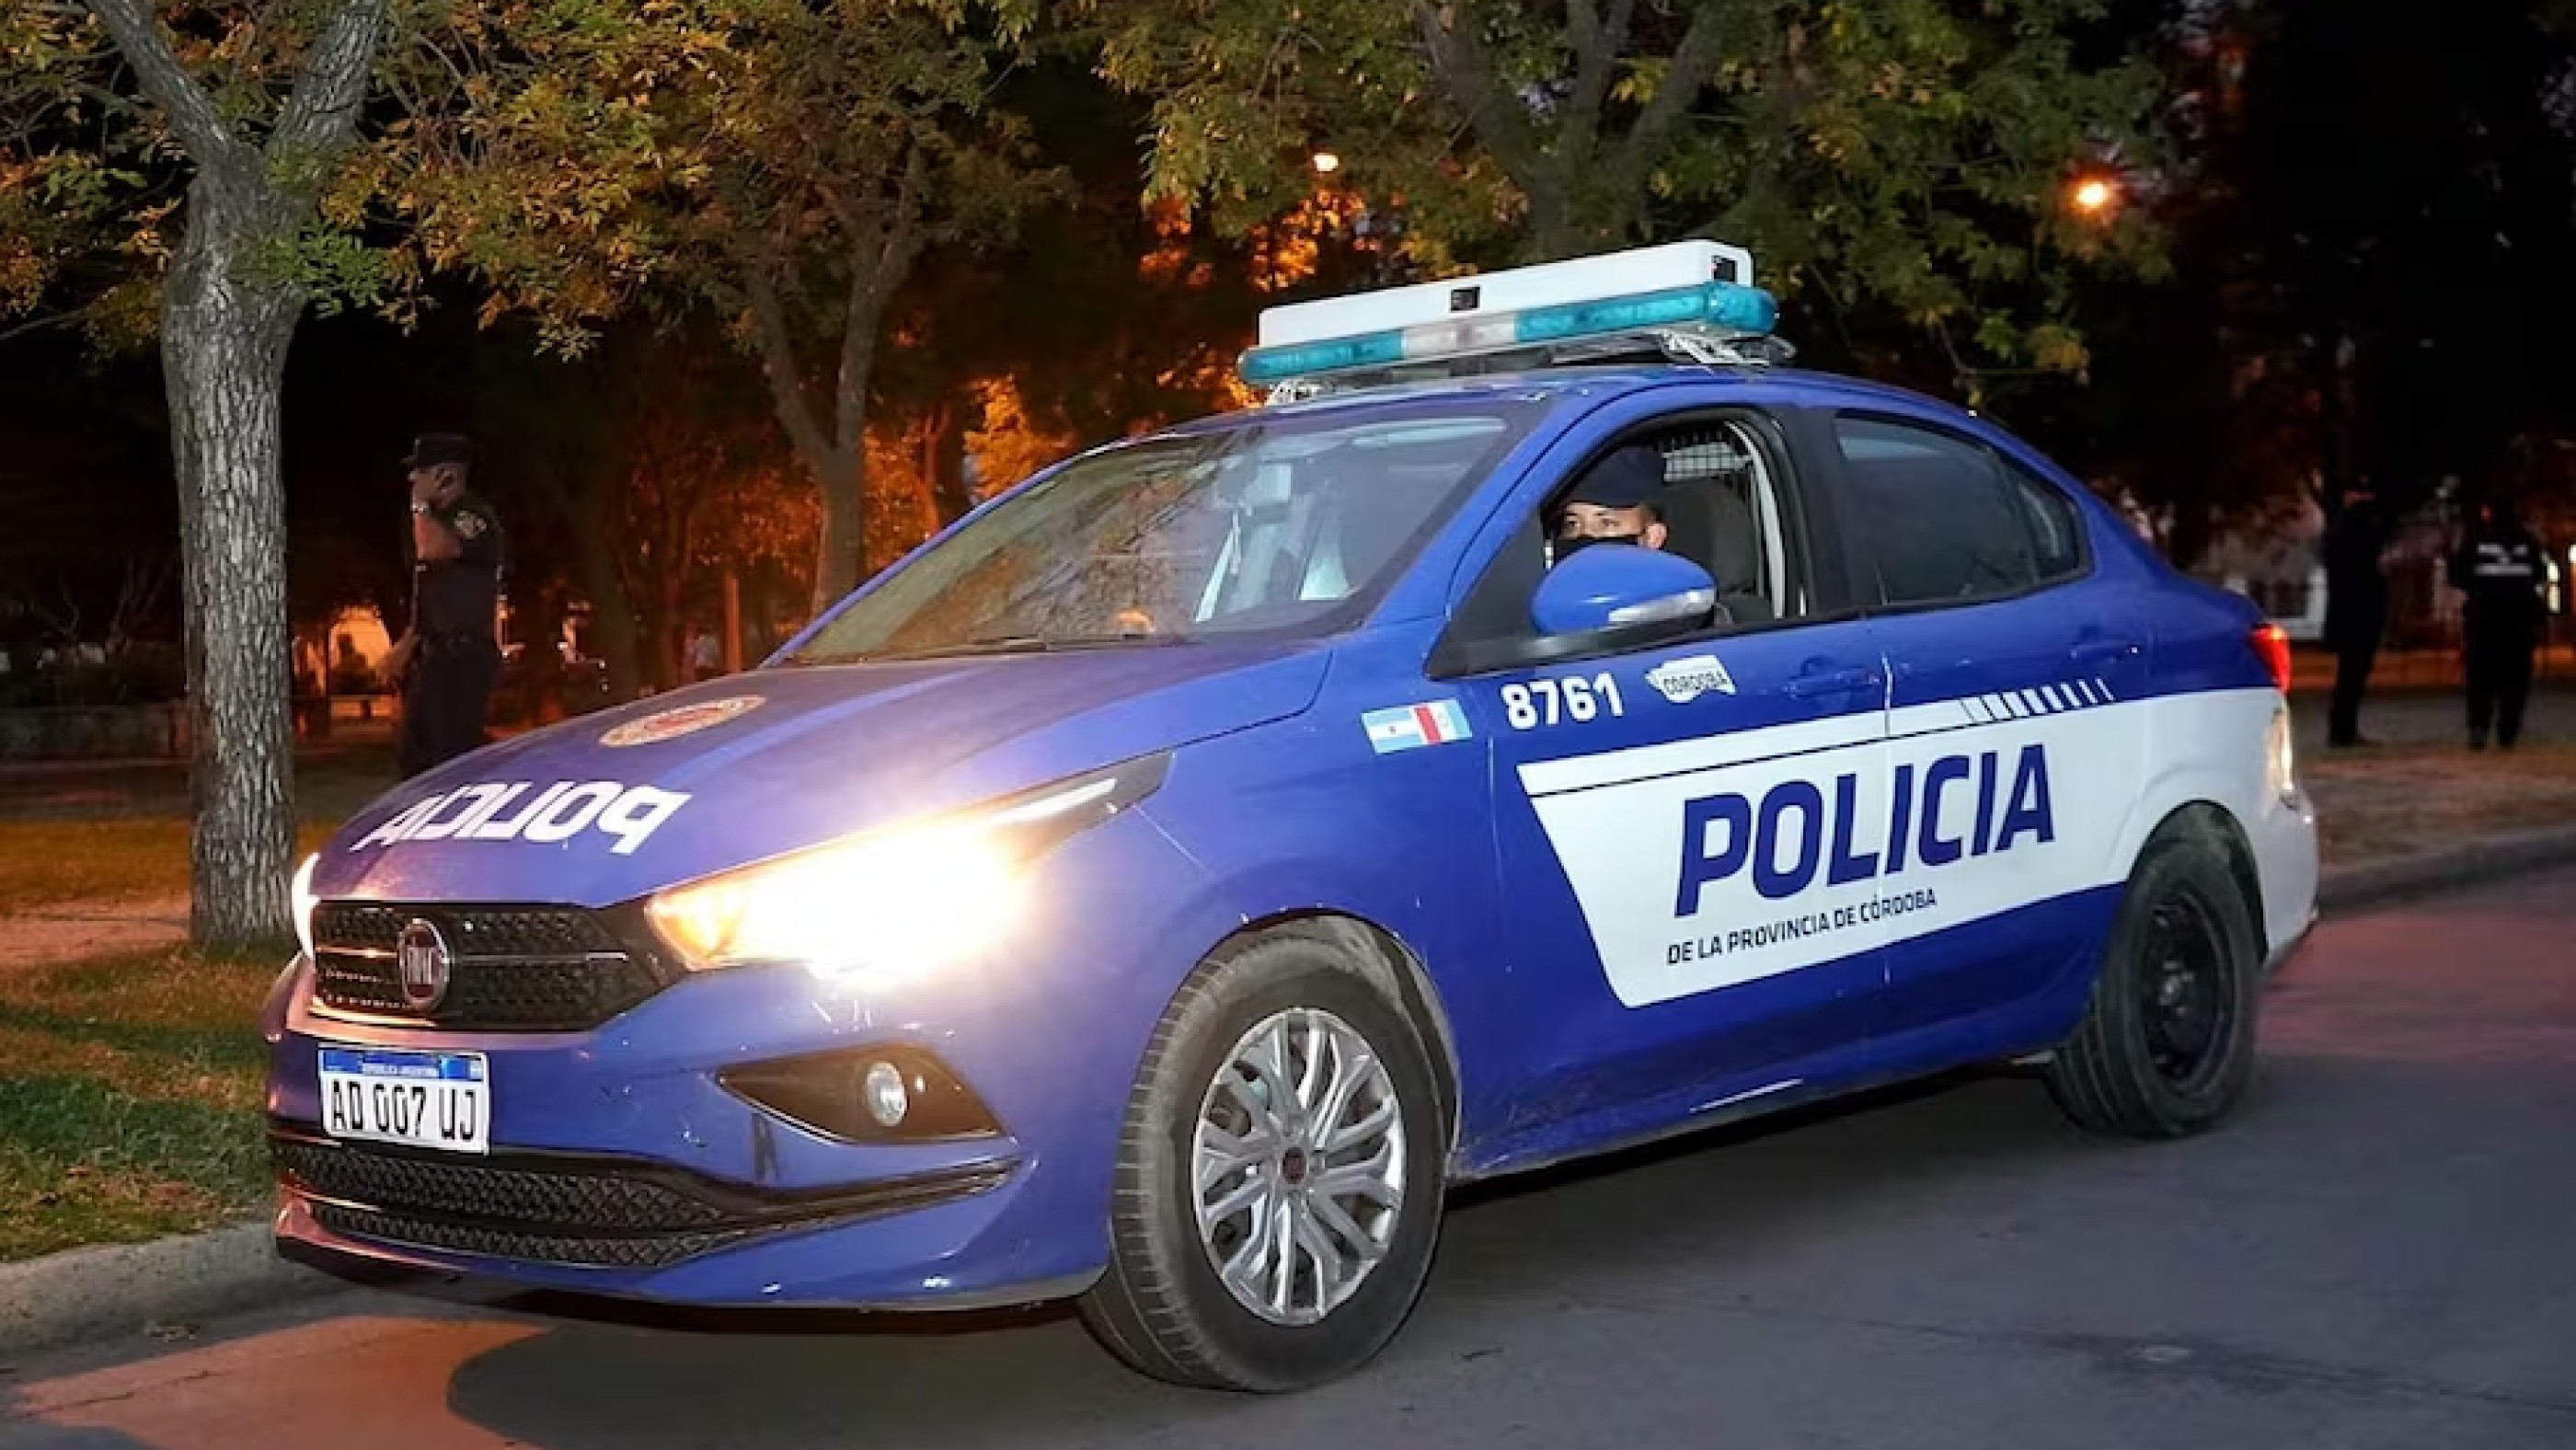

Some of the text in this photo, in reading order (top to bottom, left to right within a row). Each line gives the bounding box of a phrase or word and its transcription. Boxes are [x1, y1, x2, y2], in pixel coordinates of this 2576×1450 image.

[1501, 672, 1623, 730] 8761
[1674, 742, 2055, 918] POLICIA
[1667, 940, 1694, 965] DE
[1697, 935, 1722, 959] LA
[1727, 913, 1831, 953] PROVINCIA
[1834, 905, 1857, 929] DE
[332, 1079, 363, 1132] AD
[438, 1088, 477, 1141] UJ
